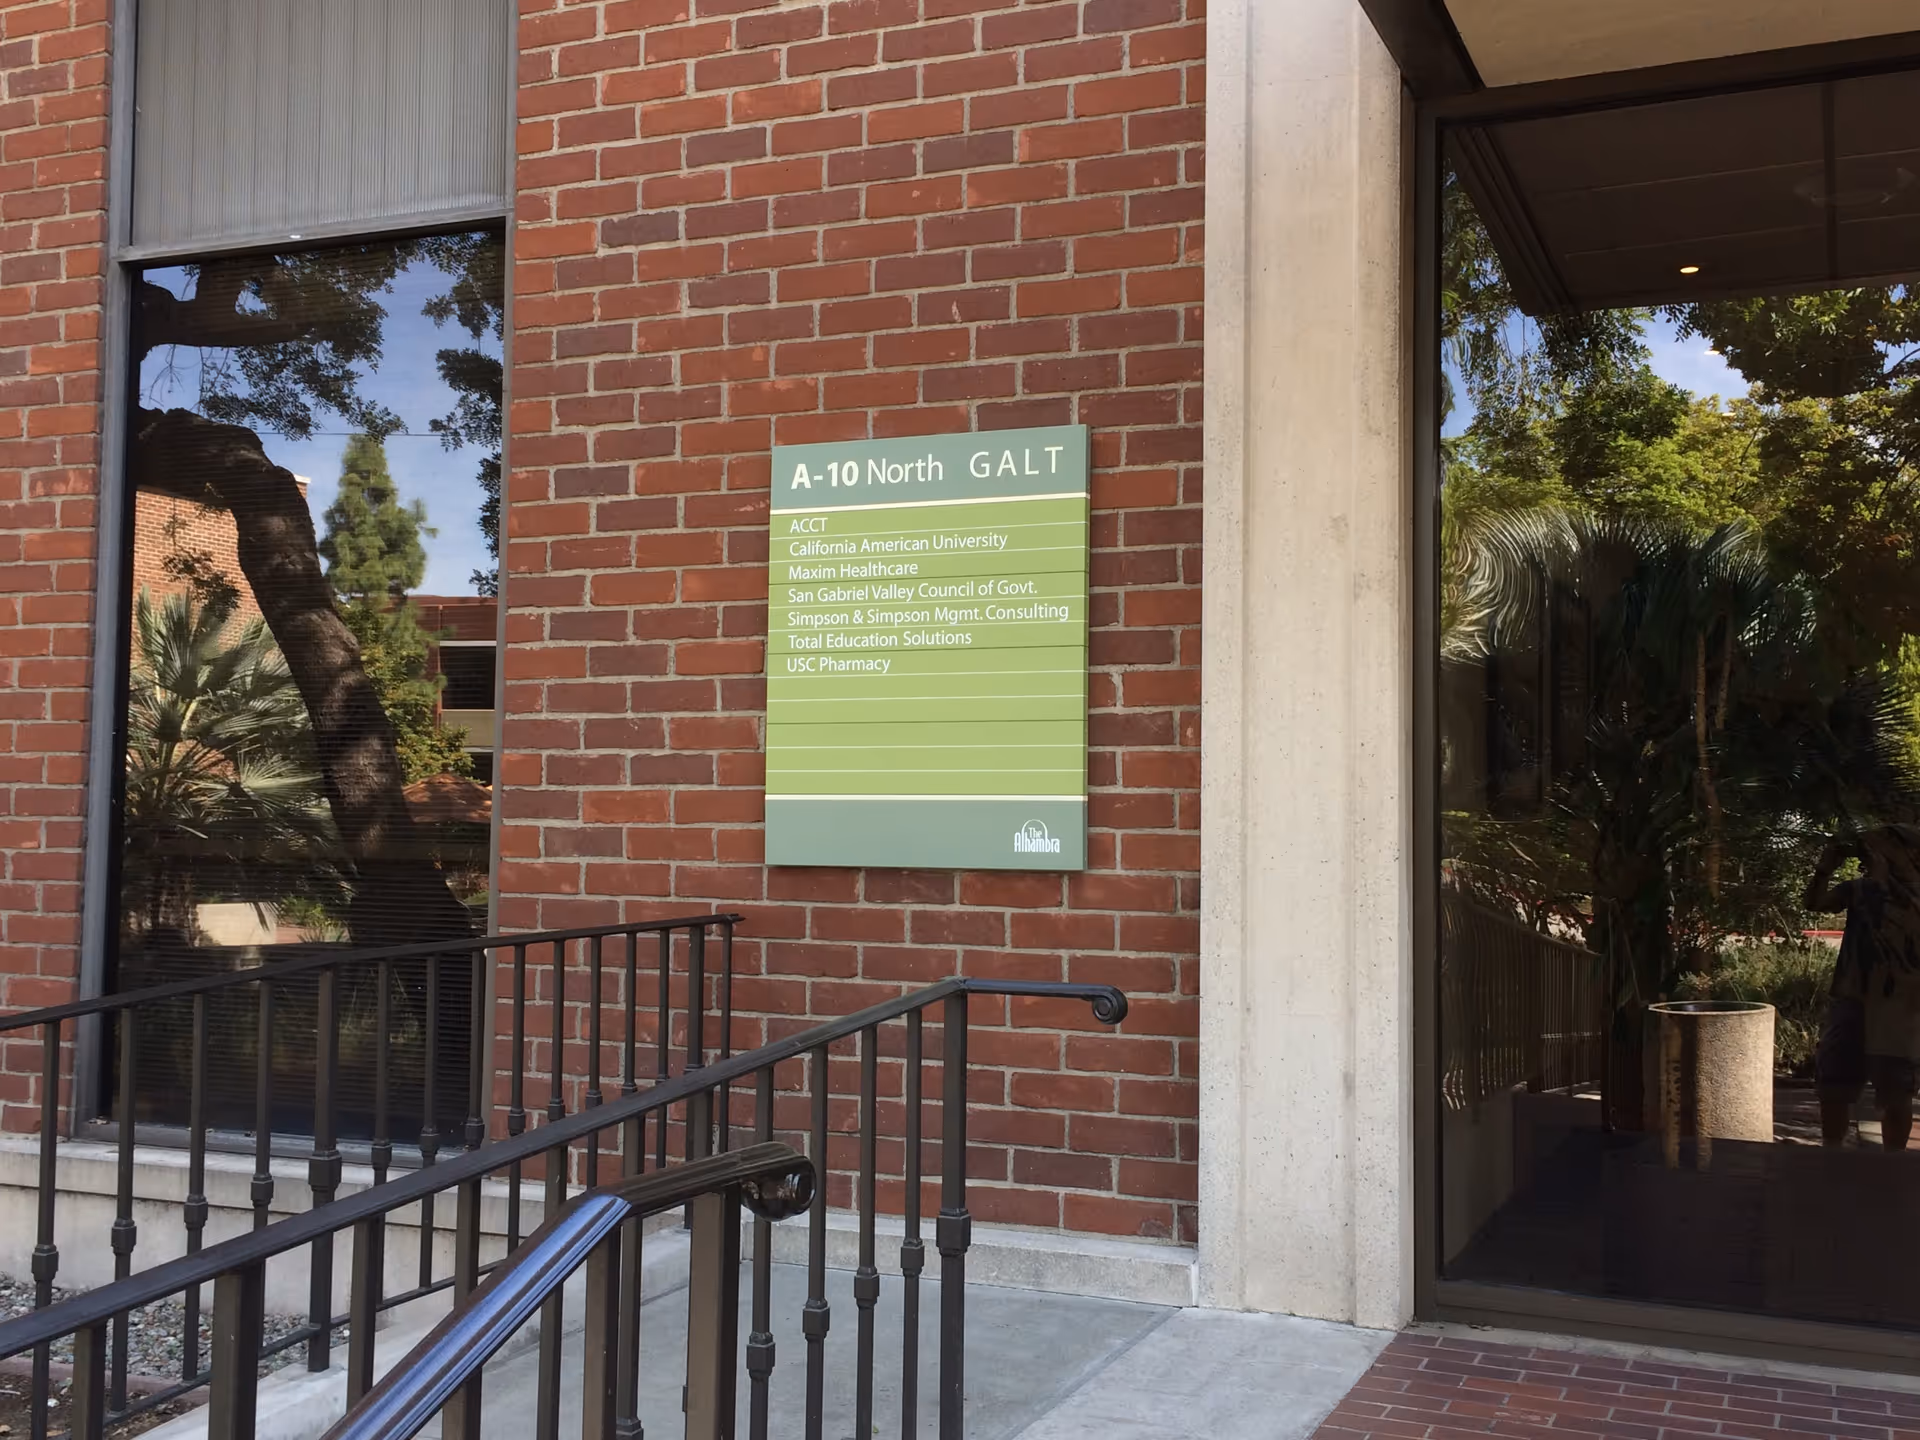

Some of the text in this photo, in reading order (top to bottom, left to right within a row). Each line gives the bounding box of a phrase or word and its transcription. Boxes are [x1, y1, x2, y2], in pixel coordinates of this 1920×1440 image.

[791, 446, 1063, 490] A-10 North GALT
[790, 518, 828, 533] ACCT
[789, 533, 1008, 556] California American University
[789, 561, 918, 579] Maxim Healthcare
[788, 580, 1038, 603] San Gabriel Valley Council of Govt.
[788, 603, 1069, 628] Simpson & Simpson Mgmt. Consulting
[788, 630, 972, 649] Total Education Solutions
[787, 656, 891, 673] USC Pharmacy
[1014, 832, 1060, 853] Alhambra
[1029, 827, 1042, 838] The
